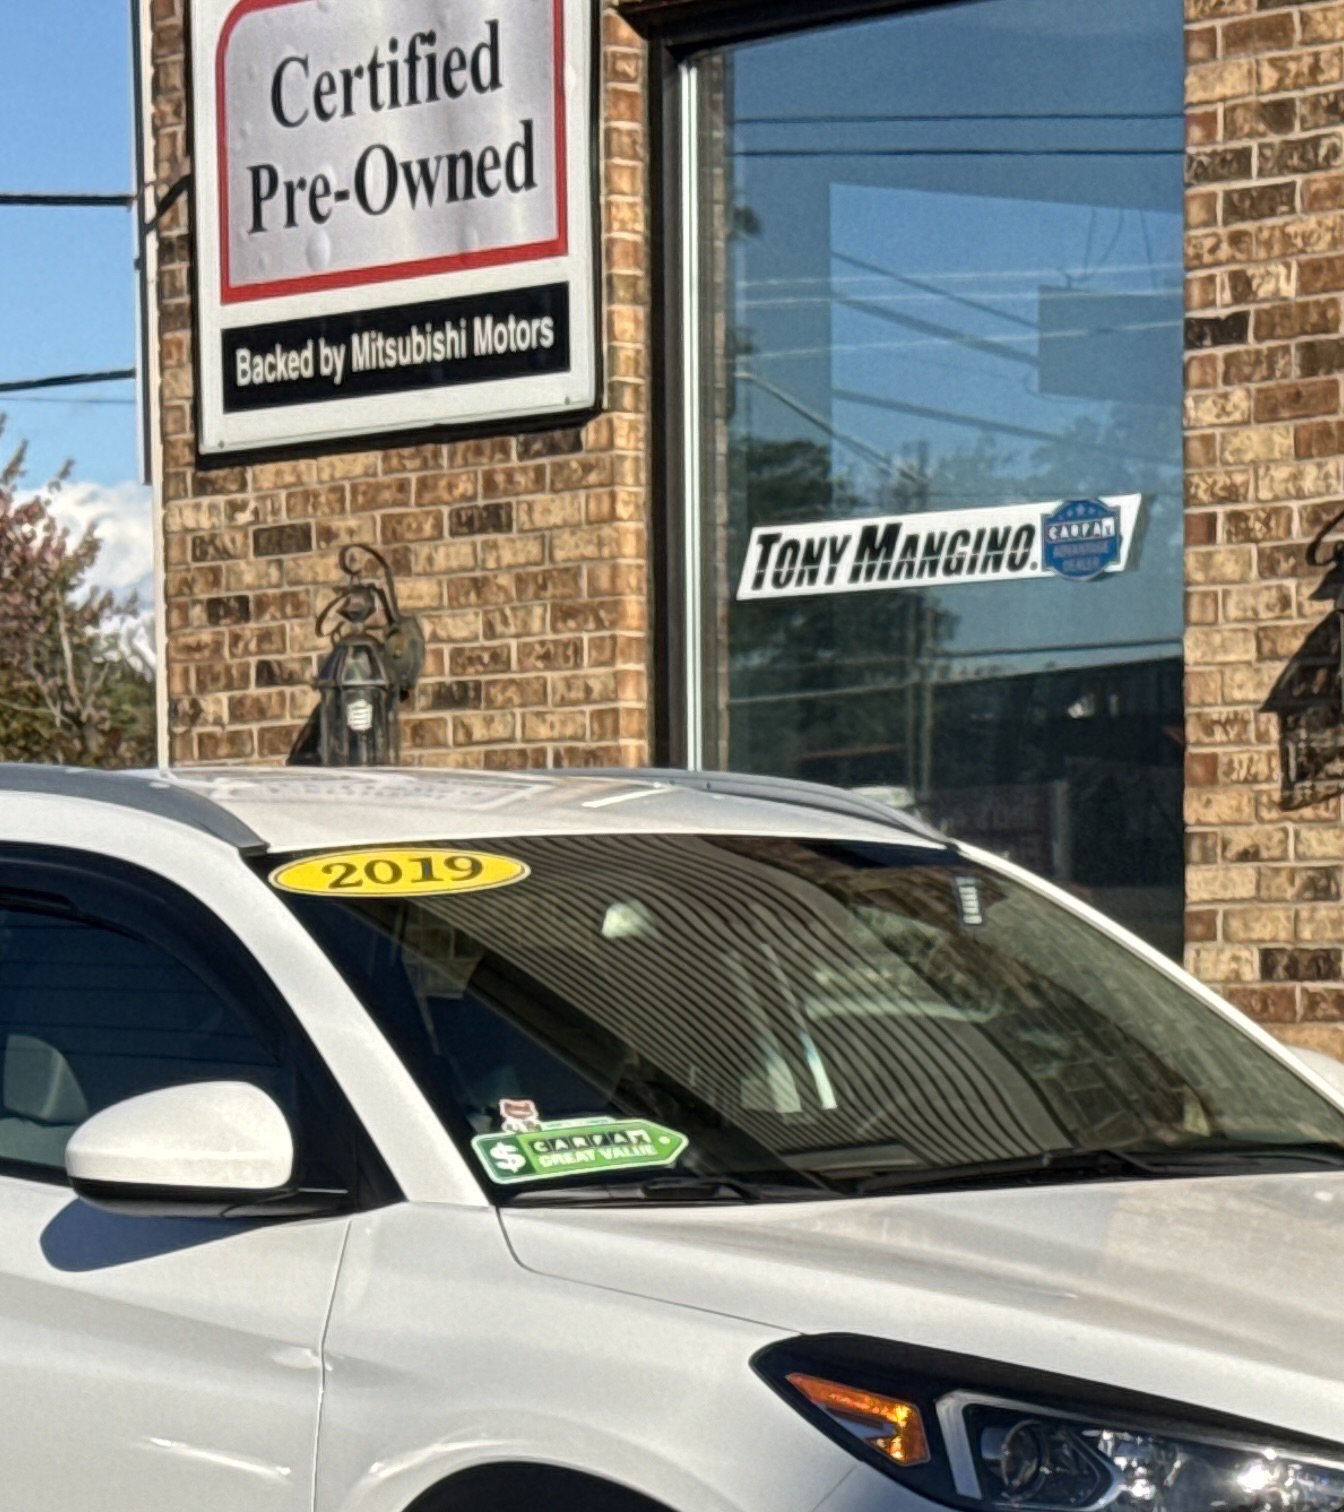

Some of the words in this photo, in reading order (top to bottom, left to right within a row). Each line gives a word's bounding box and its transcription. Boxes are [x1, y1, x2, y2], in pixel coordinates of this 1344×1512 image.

[270, 18, 503, 129] Certified
[247, 118, 538, 236] Pre-Owned
[235, 340, 314, 387] Backed
[319, 337, 346, 385] by
[350, 319, 467, 373] Mitsubishi
[473, 314, 555, 354] Motors
[751, 532, 852, 591] TONY
[320, 855, 485, 890] 2019
[532, 1128, 653, 1153] CARFAX
[538, 1149, 597, 1168] GREAT
[598, 1143, 658, 1160] VALUE
